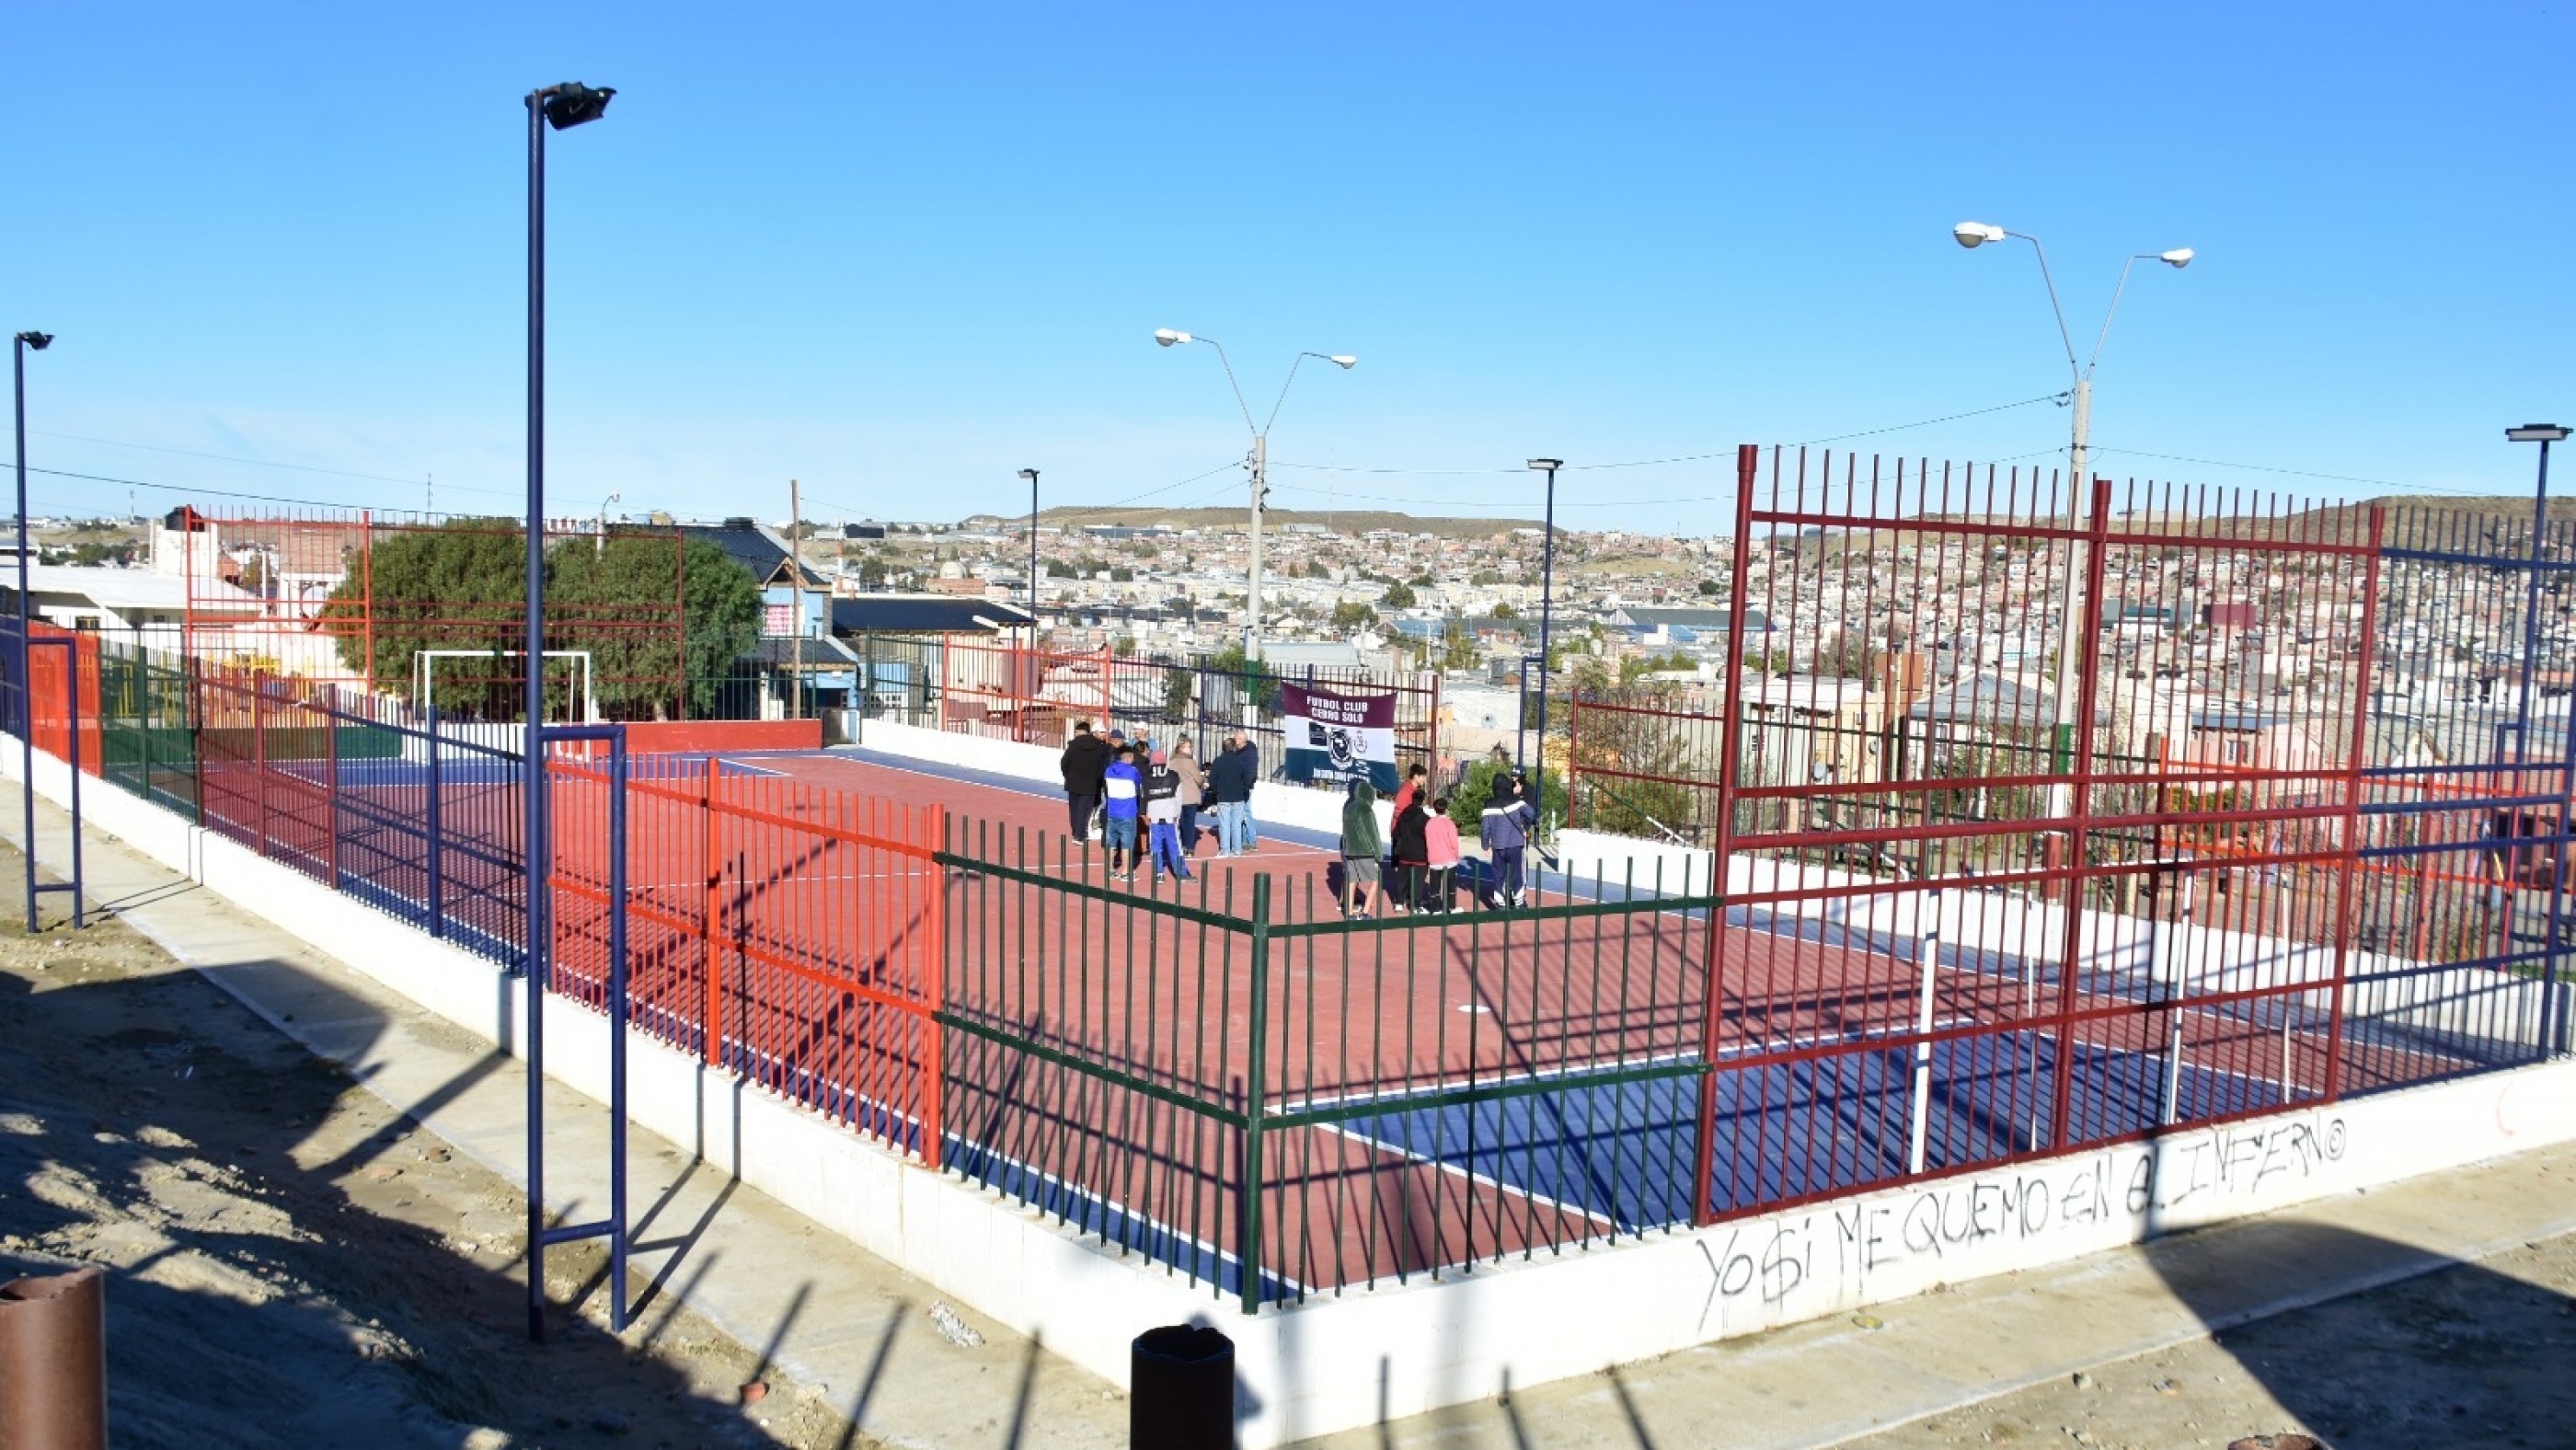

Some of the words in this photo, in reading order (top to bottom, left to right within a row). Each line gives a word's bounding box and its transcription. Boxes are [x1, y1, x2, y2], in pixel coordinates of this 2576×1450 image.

[1306, 696, 1341, 710] FUTBOL
[1343, 701, 1368, 712] CLUB
[1341, 711, 1363, 724] SOLO
